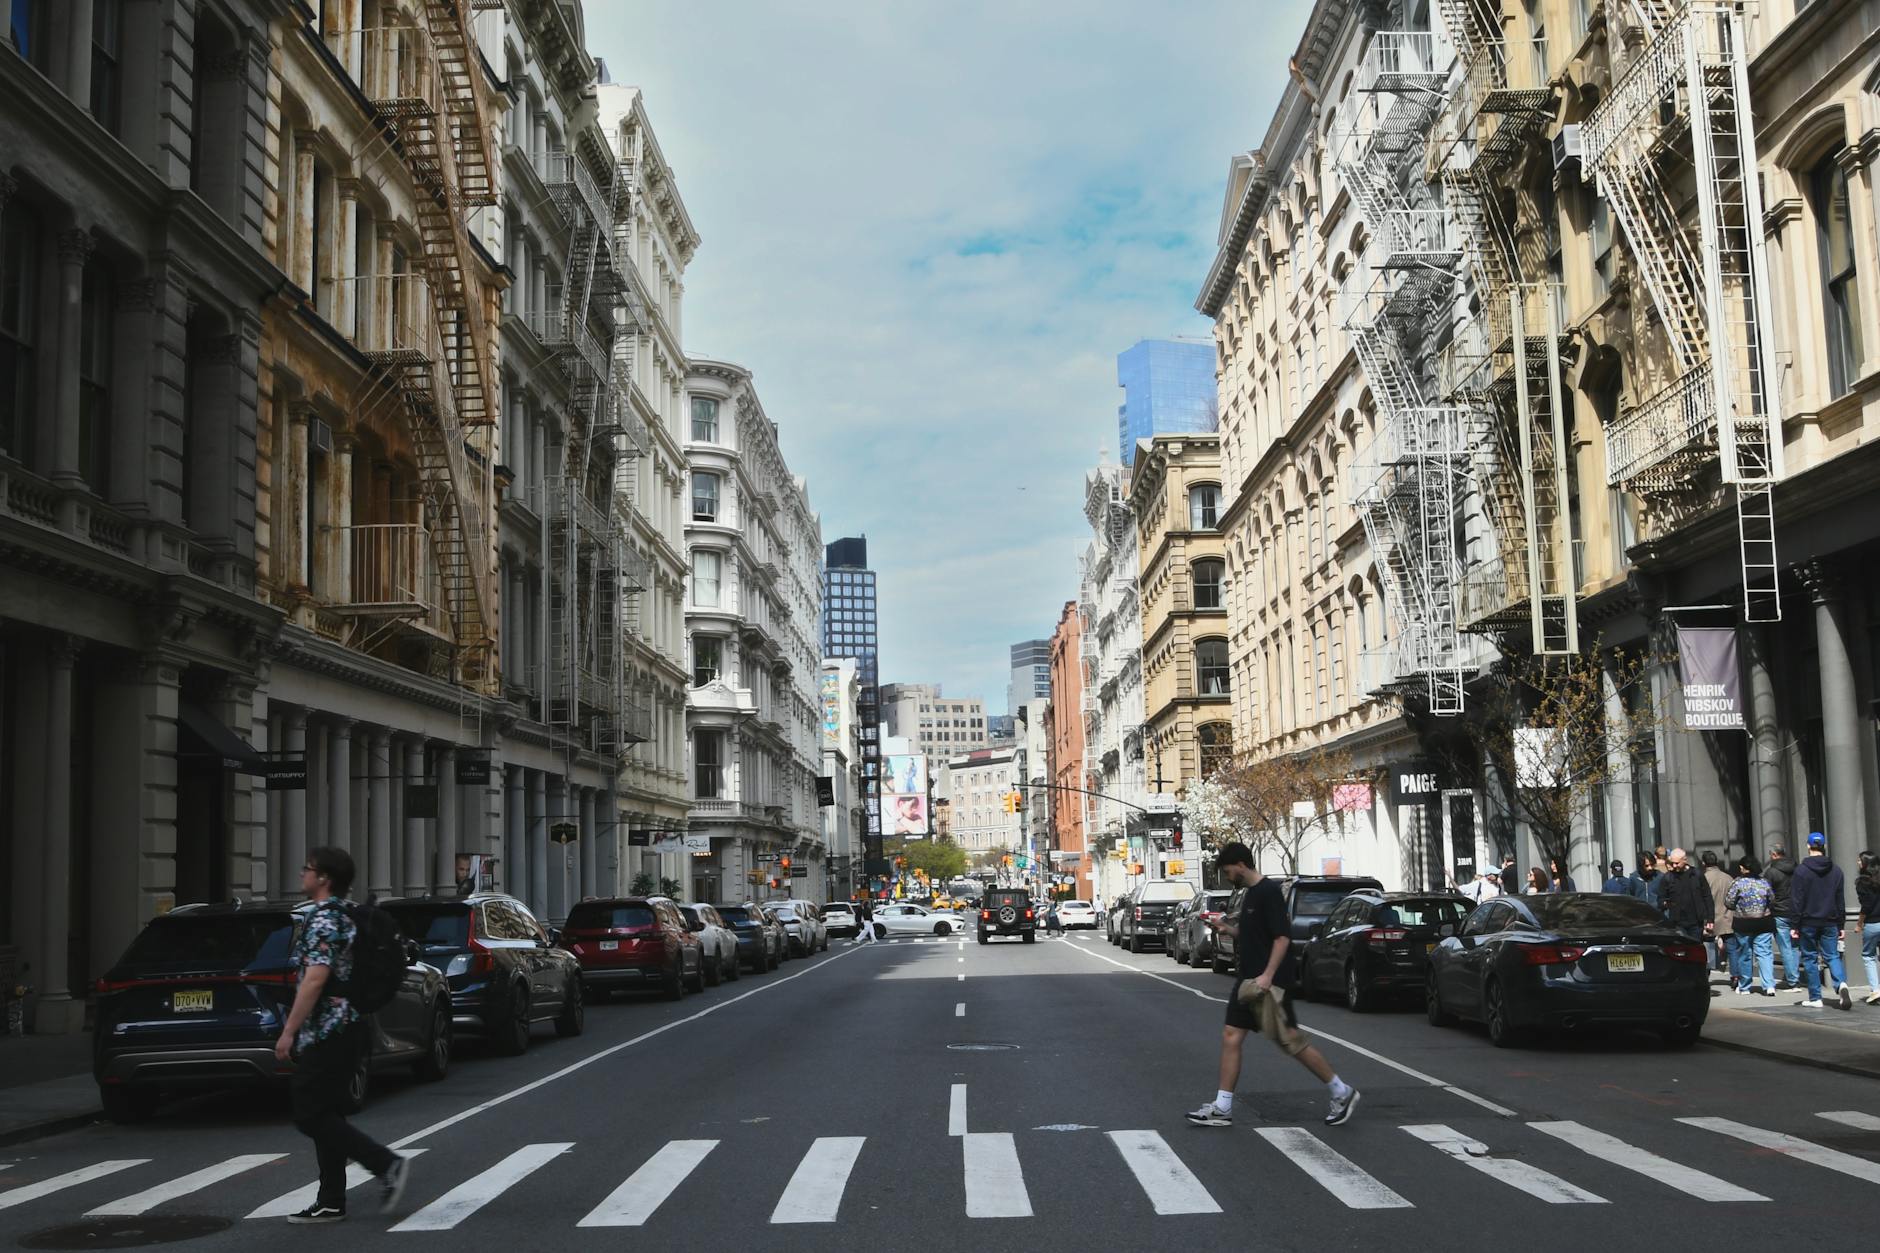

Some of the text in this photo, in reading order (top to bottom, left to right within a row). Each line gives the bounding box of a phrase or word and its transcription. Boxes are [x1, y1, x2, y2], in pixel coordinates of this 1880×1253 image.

[1683, 684, 1726, 697] HENRIK
[1684, 698, 1734, 712] VIBSKOV
[1685, 712, 1745, 726] BOUTIQUE
[1400, 773, 1438, 794] PAIGE
